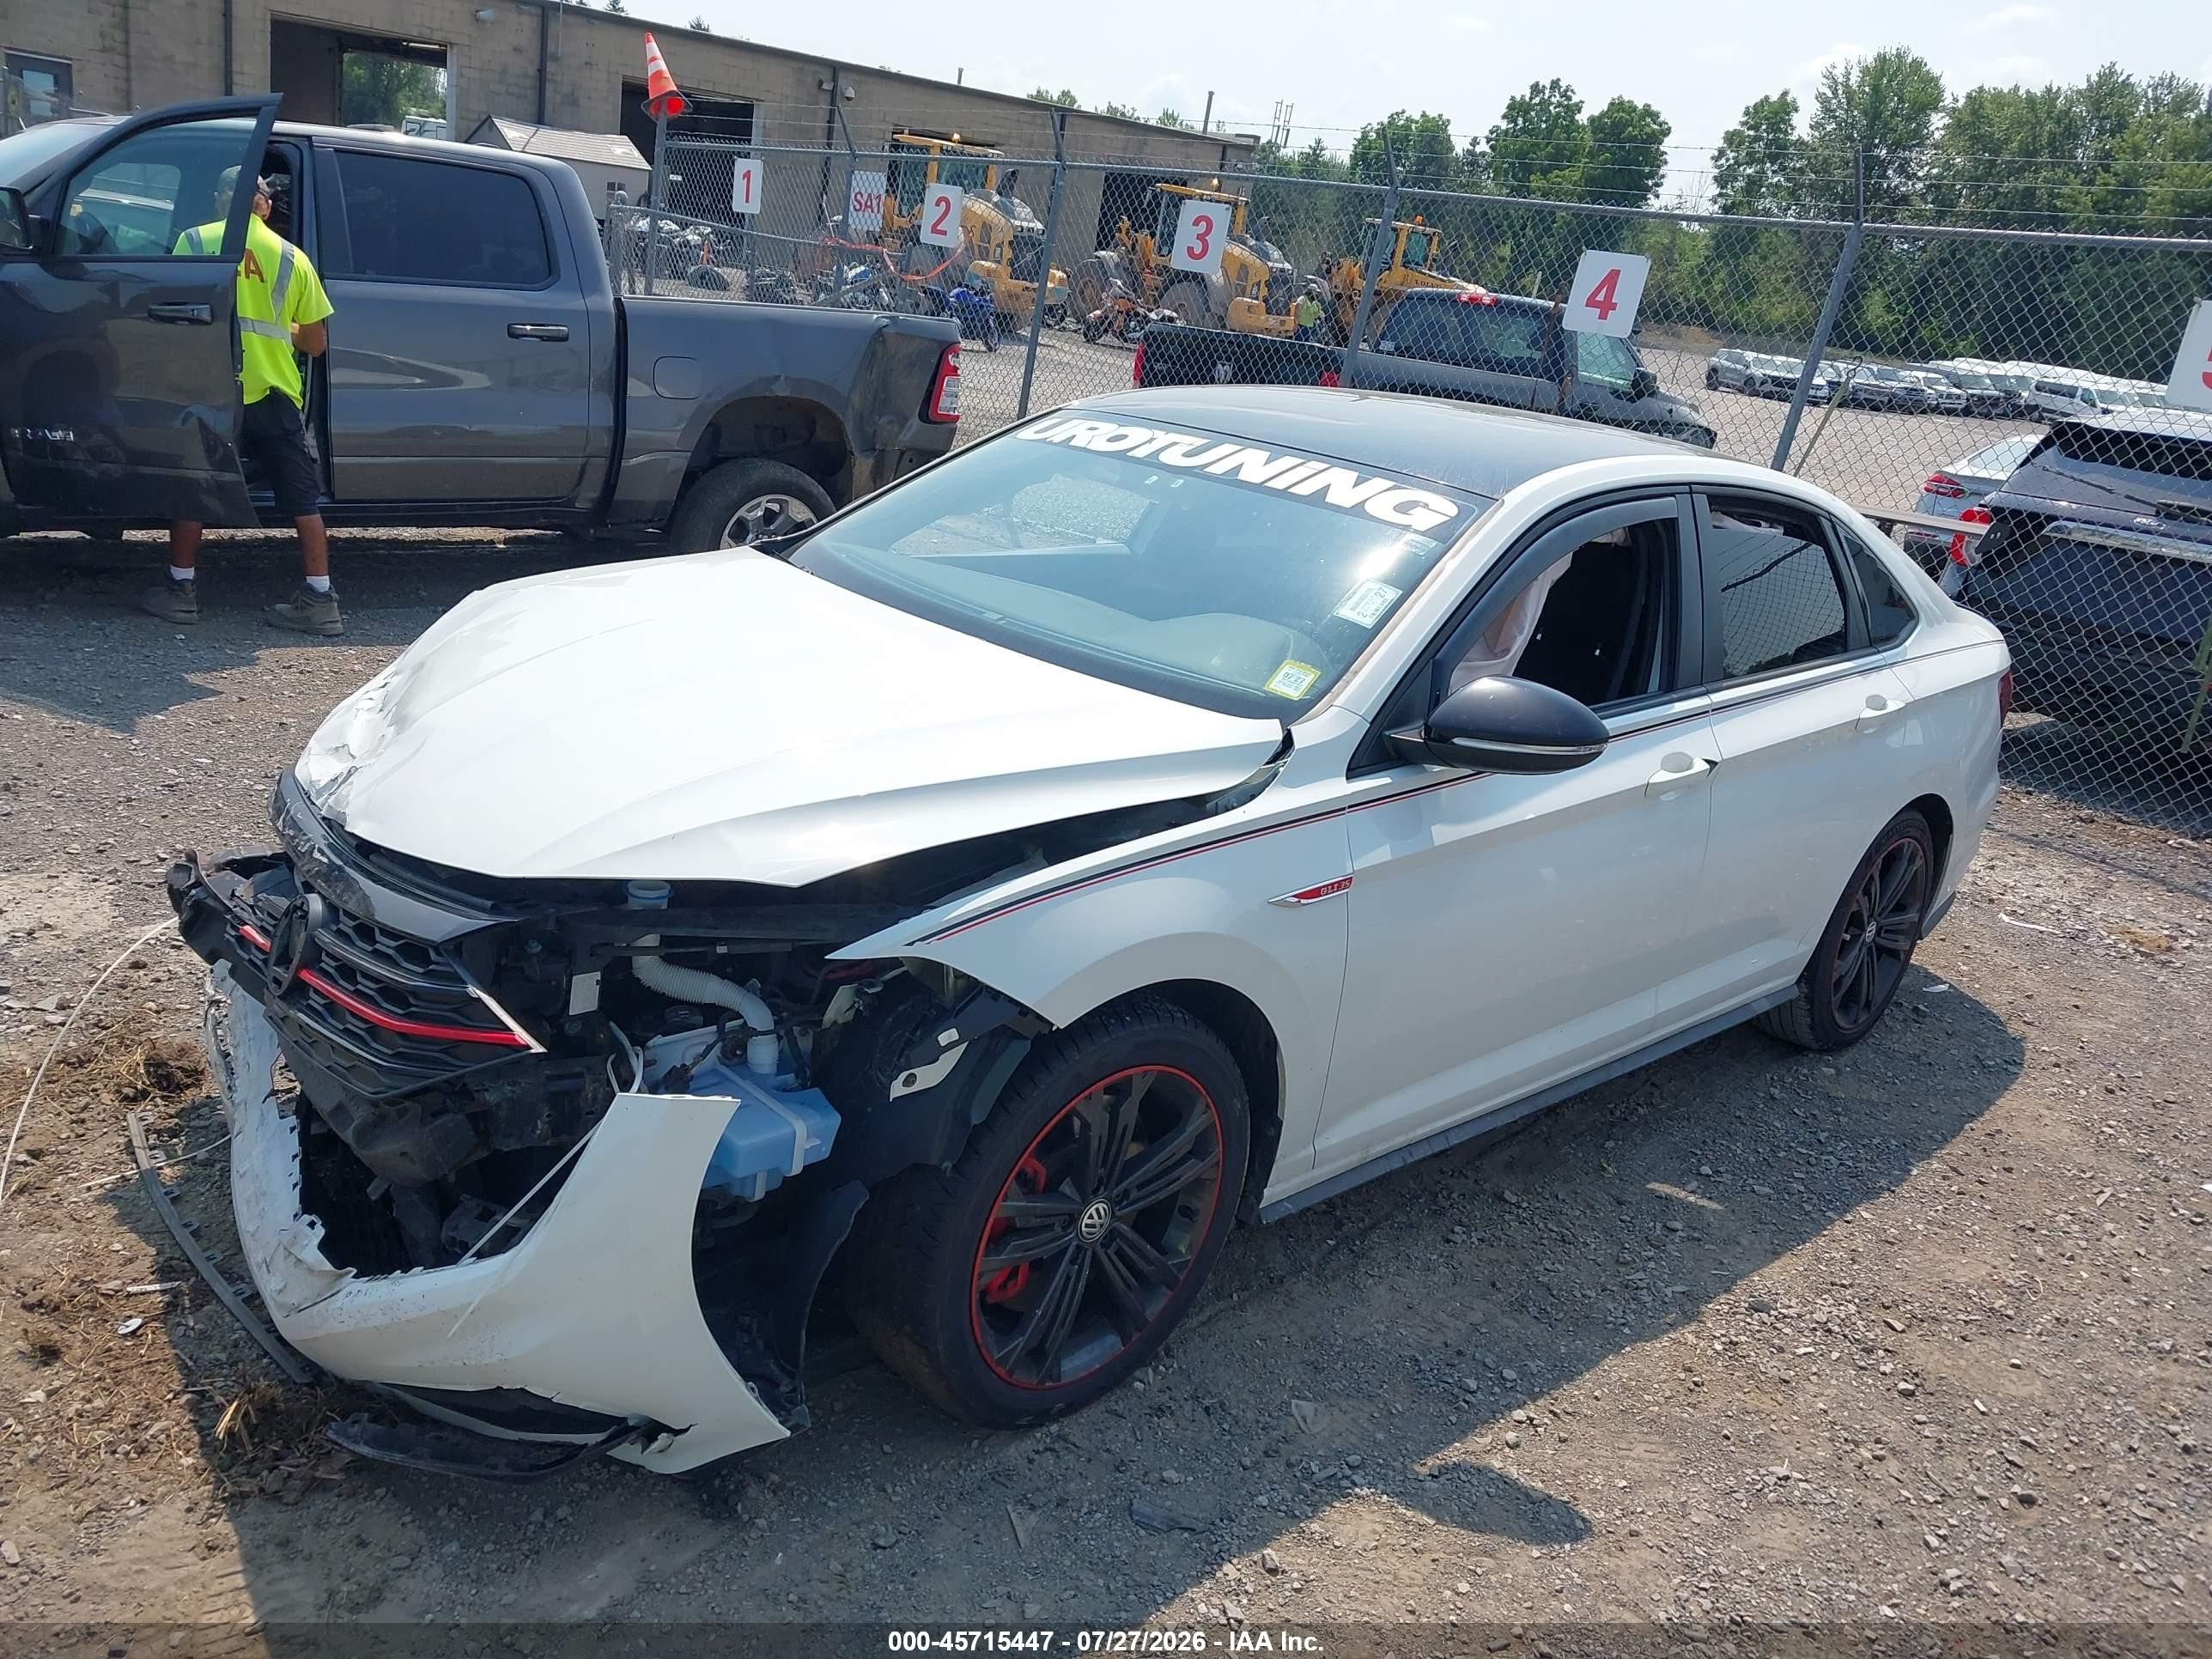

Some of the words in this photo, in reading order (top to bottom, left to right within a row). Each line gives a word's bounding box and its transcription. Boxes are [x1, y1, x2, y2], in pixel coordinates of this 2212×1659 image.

[742, 169, 752, 204] 1
[853, 191, 883, 215] SA1
[930, 196, 952, 236] 2
[1187, 215, 1213, 260] 3
[1584, 268, 1620, 320] 4
